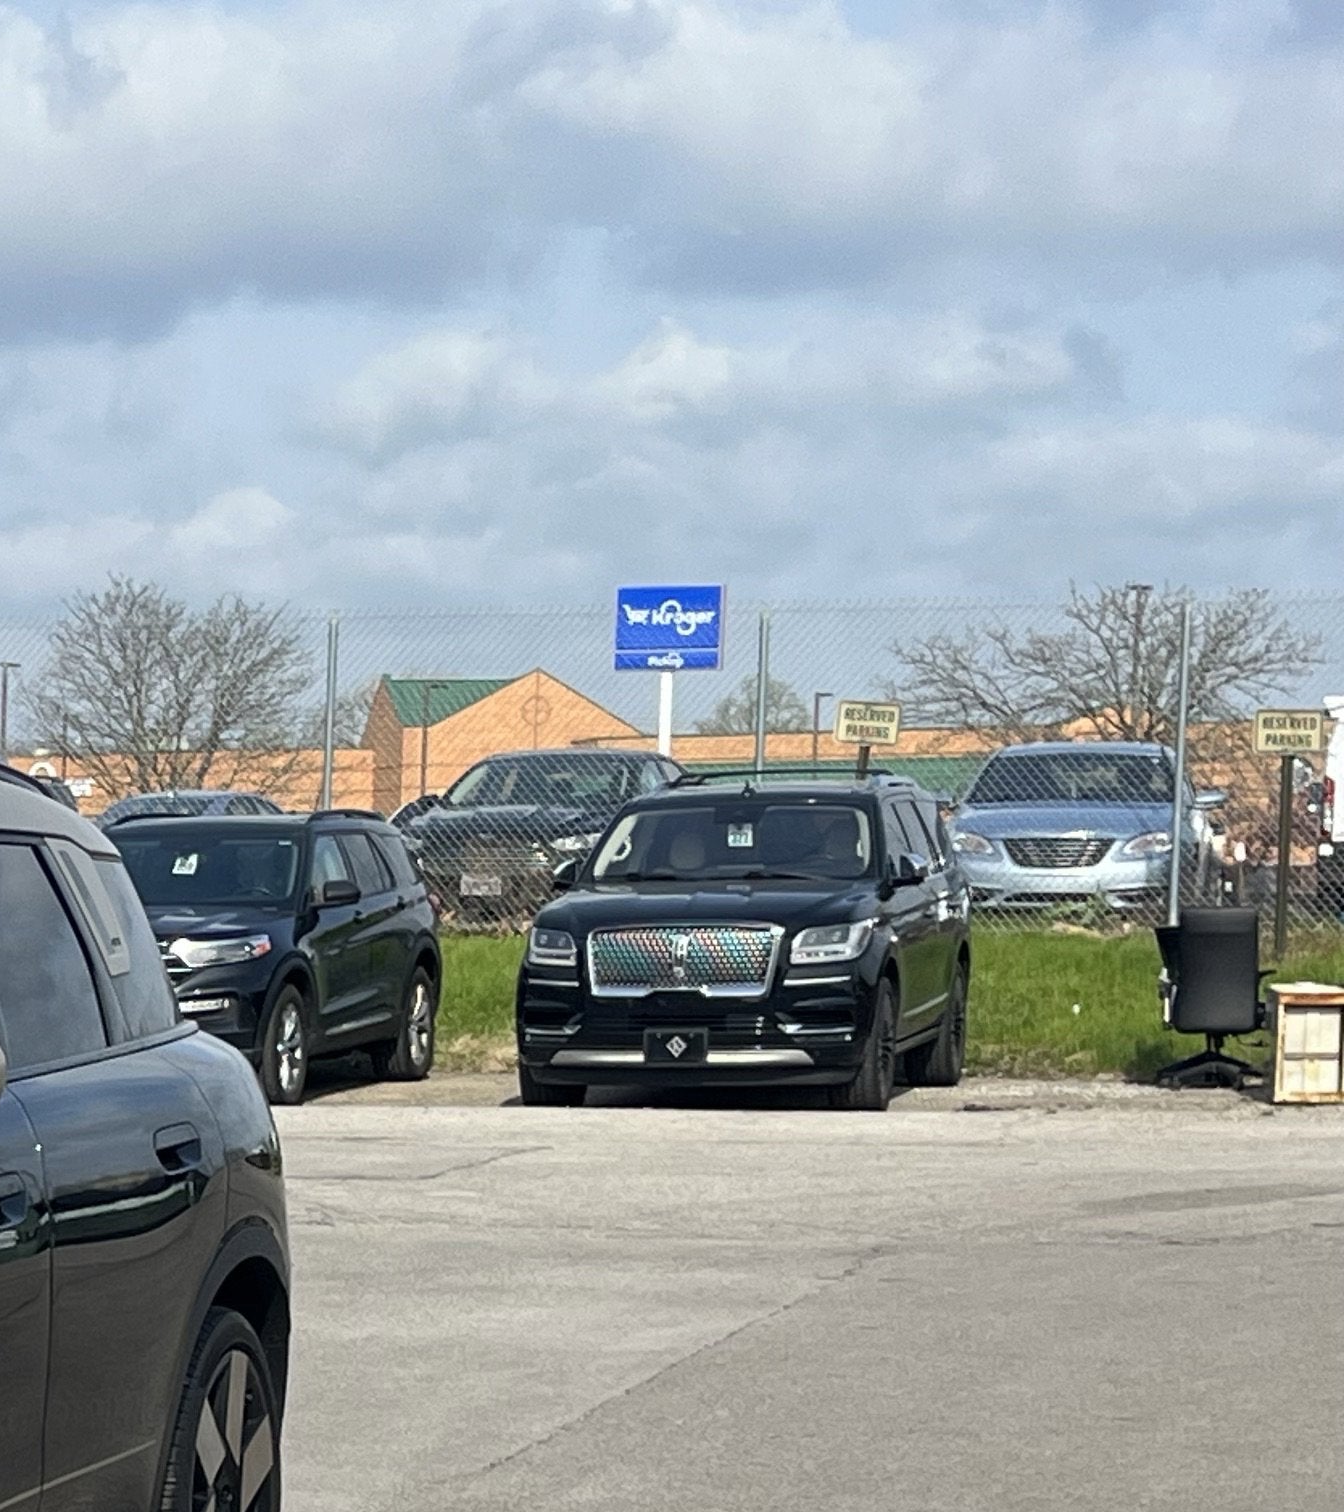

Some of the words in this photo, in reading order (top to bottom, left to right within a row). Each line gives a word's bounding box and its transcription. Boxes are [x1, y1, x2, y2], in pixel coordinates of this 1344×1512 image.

[651, 599, 716, 636] Kroger
[844, 707, 896, 723] RESERVED
[845, 723, 890, 739] PARKING
[1263, 717, 1317, 731] RESERVED
[1265, 733, 1313, 748] PARKING
